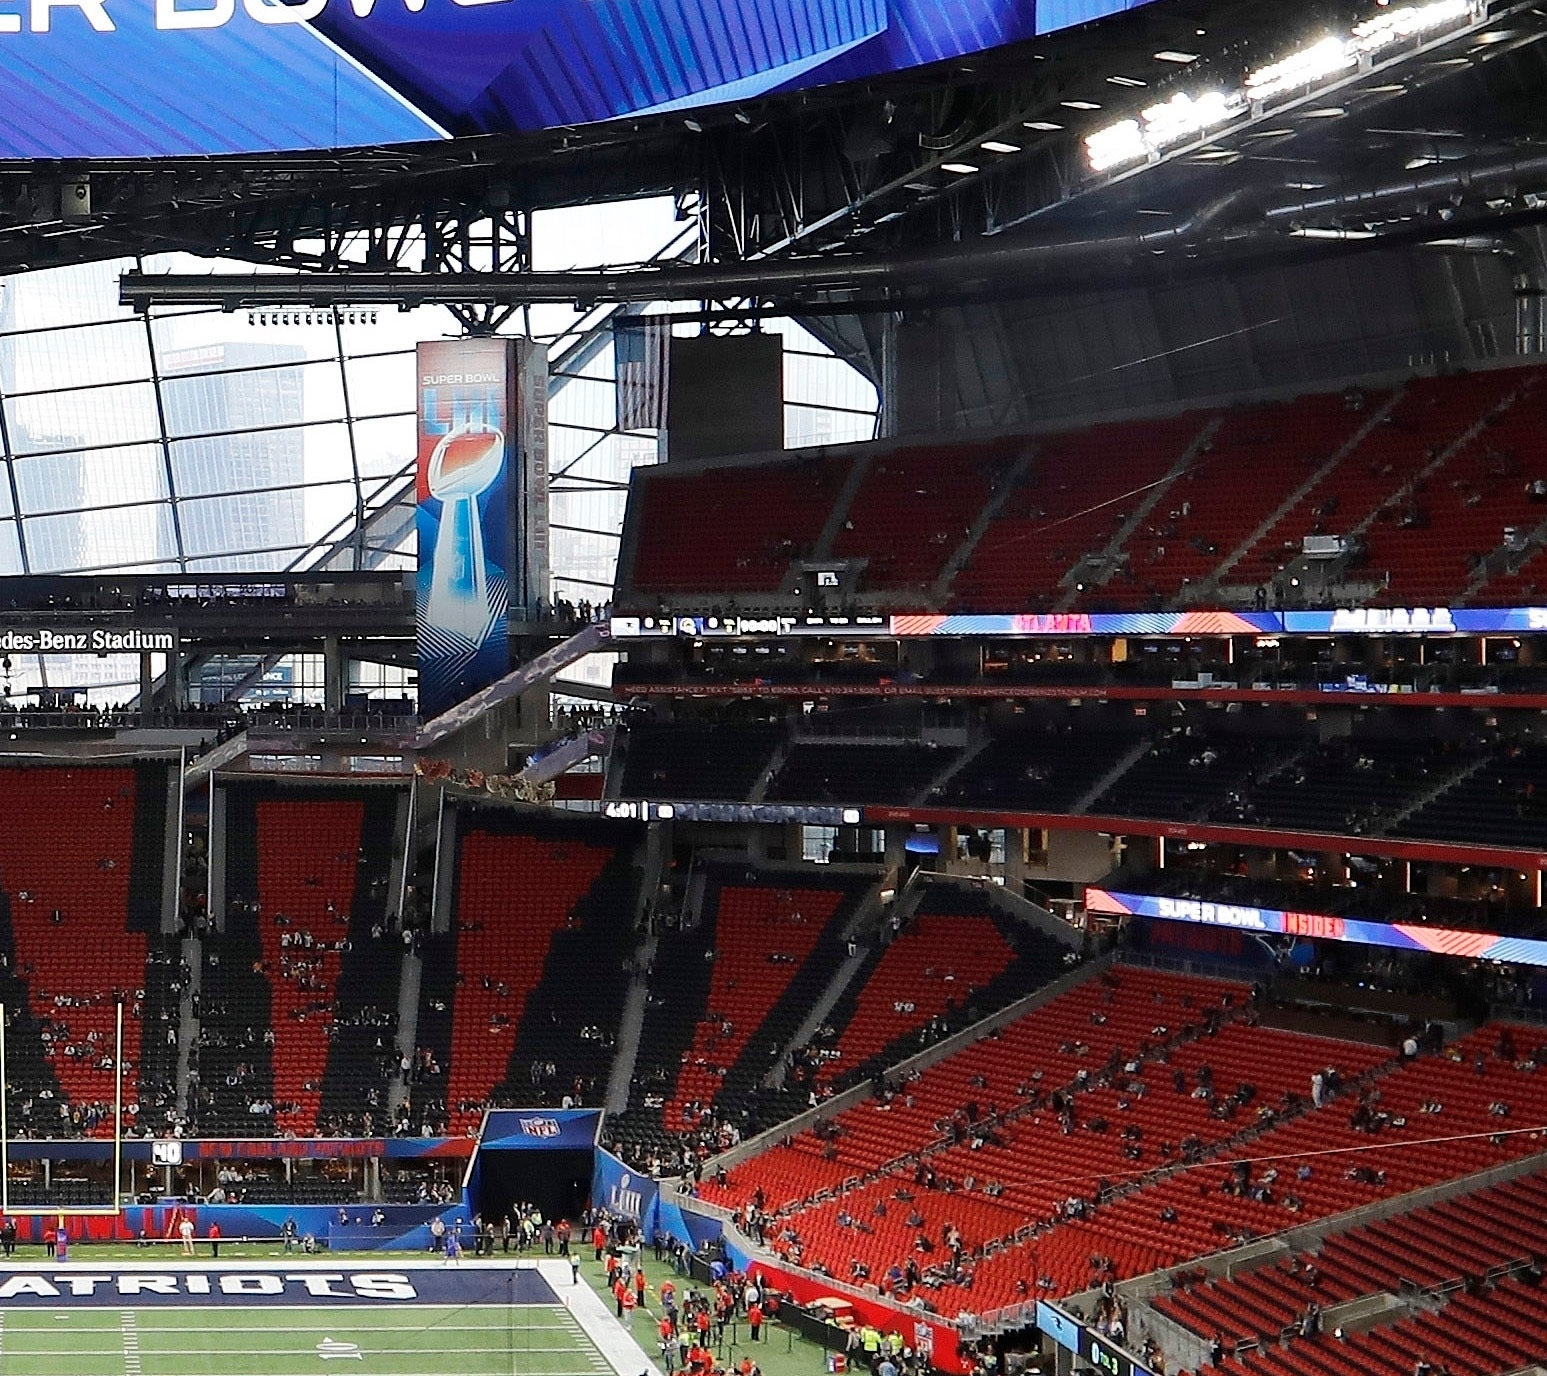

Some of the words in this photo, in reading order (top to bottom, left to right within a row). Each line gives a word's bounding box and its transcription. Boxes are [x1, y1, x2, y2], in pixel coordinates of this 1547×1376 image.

[422, 374, 462, 386] SUPER
[465, 373, 500, 384] BOWL
[91, 630, 173, 649] Stadium
[1158, 898, 1214, 923] SUPER
[1217, 904, 1266, 929] BOWL
[315, 1342, 363, 1361] 10
[1111, 1358, 1119, 1375] 3
